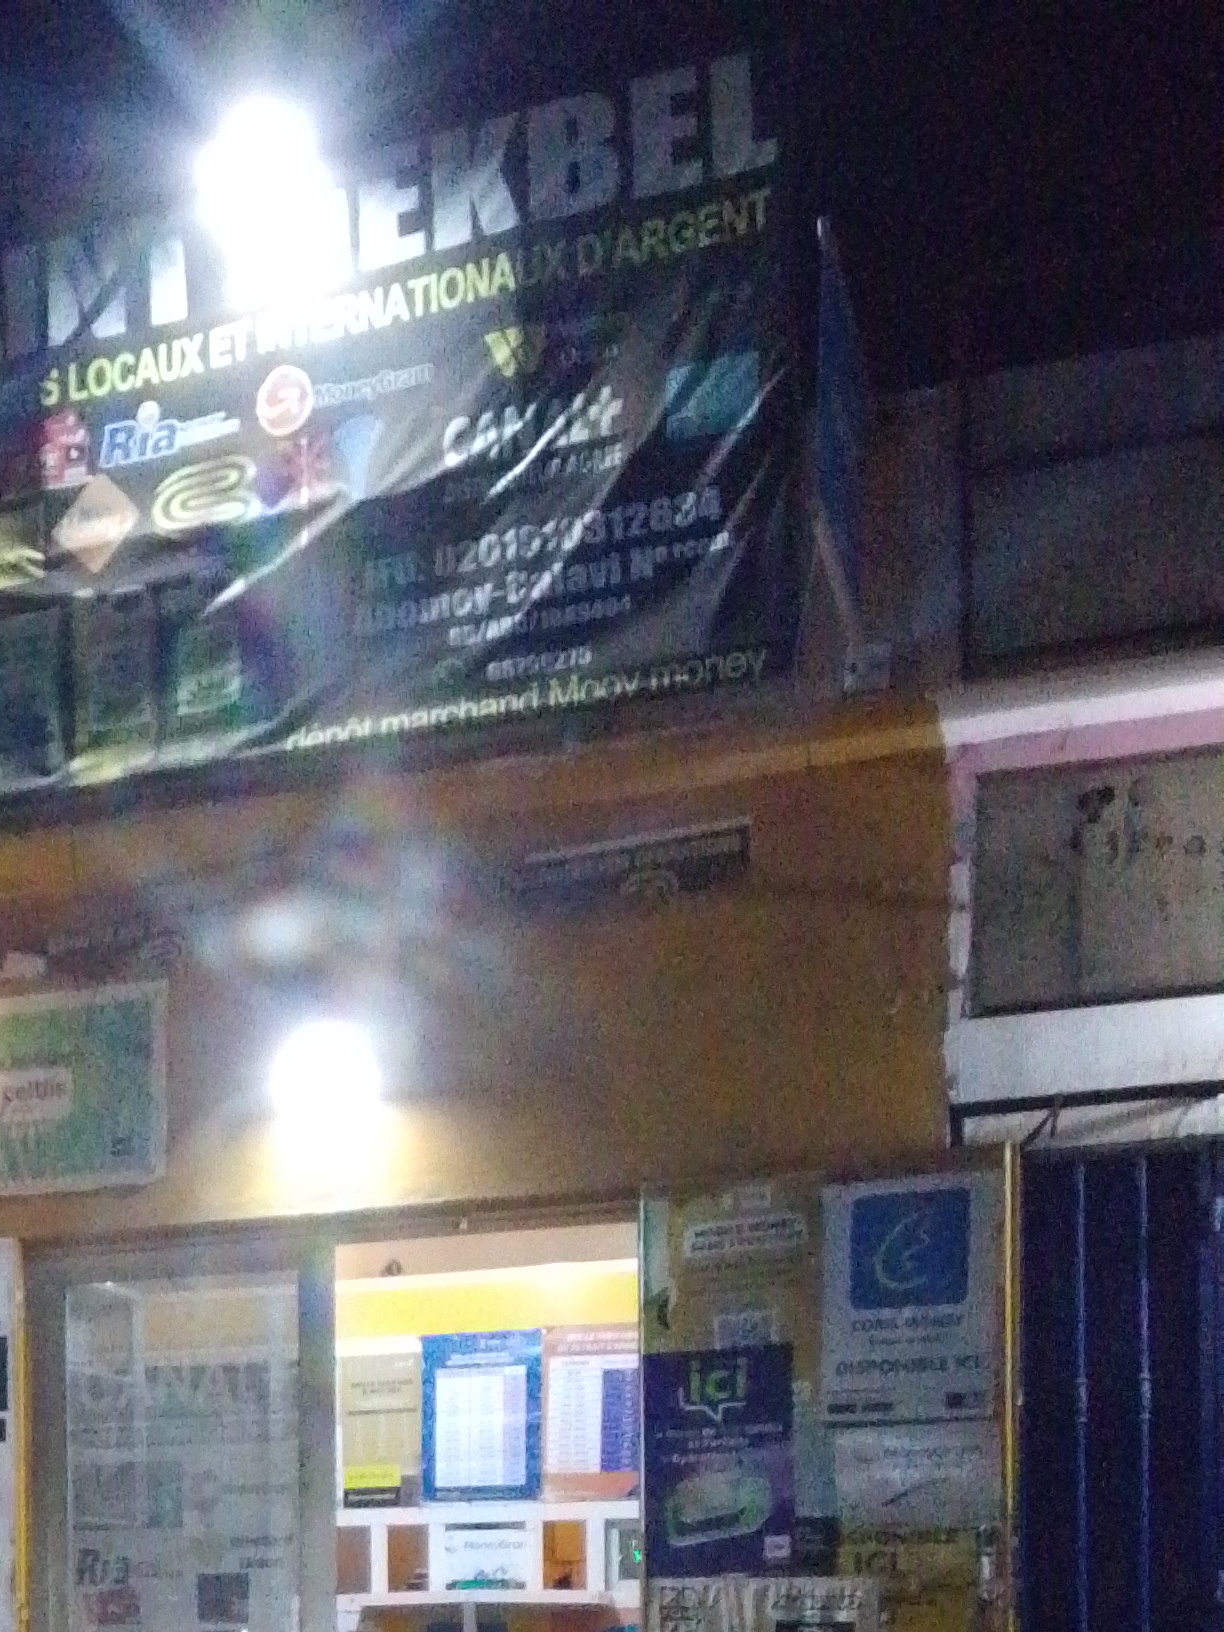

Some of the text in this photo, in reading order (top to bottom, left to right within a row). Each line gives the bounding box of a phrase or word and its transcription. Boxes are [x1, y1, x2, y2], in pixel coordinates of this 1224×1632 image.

[276, 52, 779, 296] EKBEL
[67, 333, 204, 403] LOCAUX
[210, 317, 249, 369] ET
[579, 186, 773, 285] D'ARGENT
[100, 400, 179, 467] Ria
[379, 680, 540, 733] marchand
[649, 647, 766, 693] money
